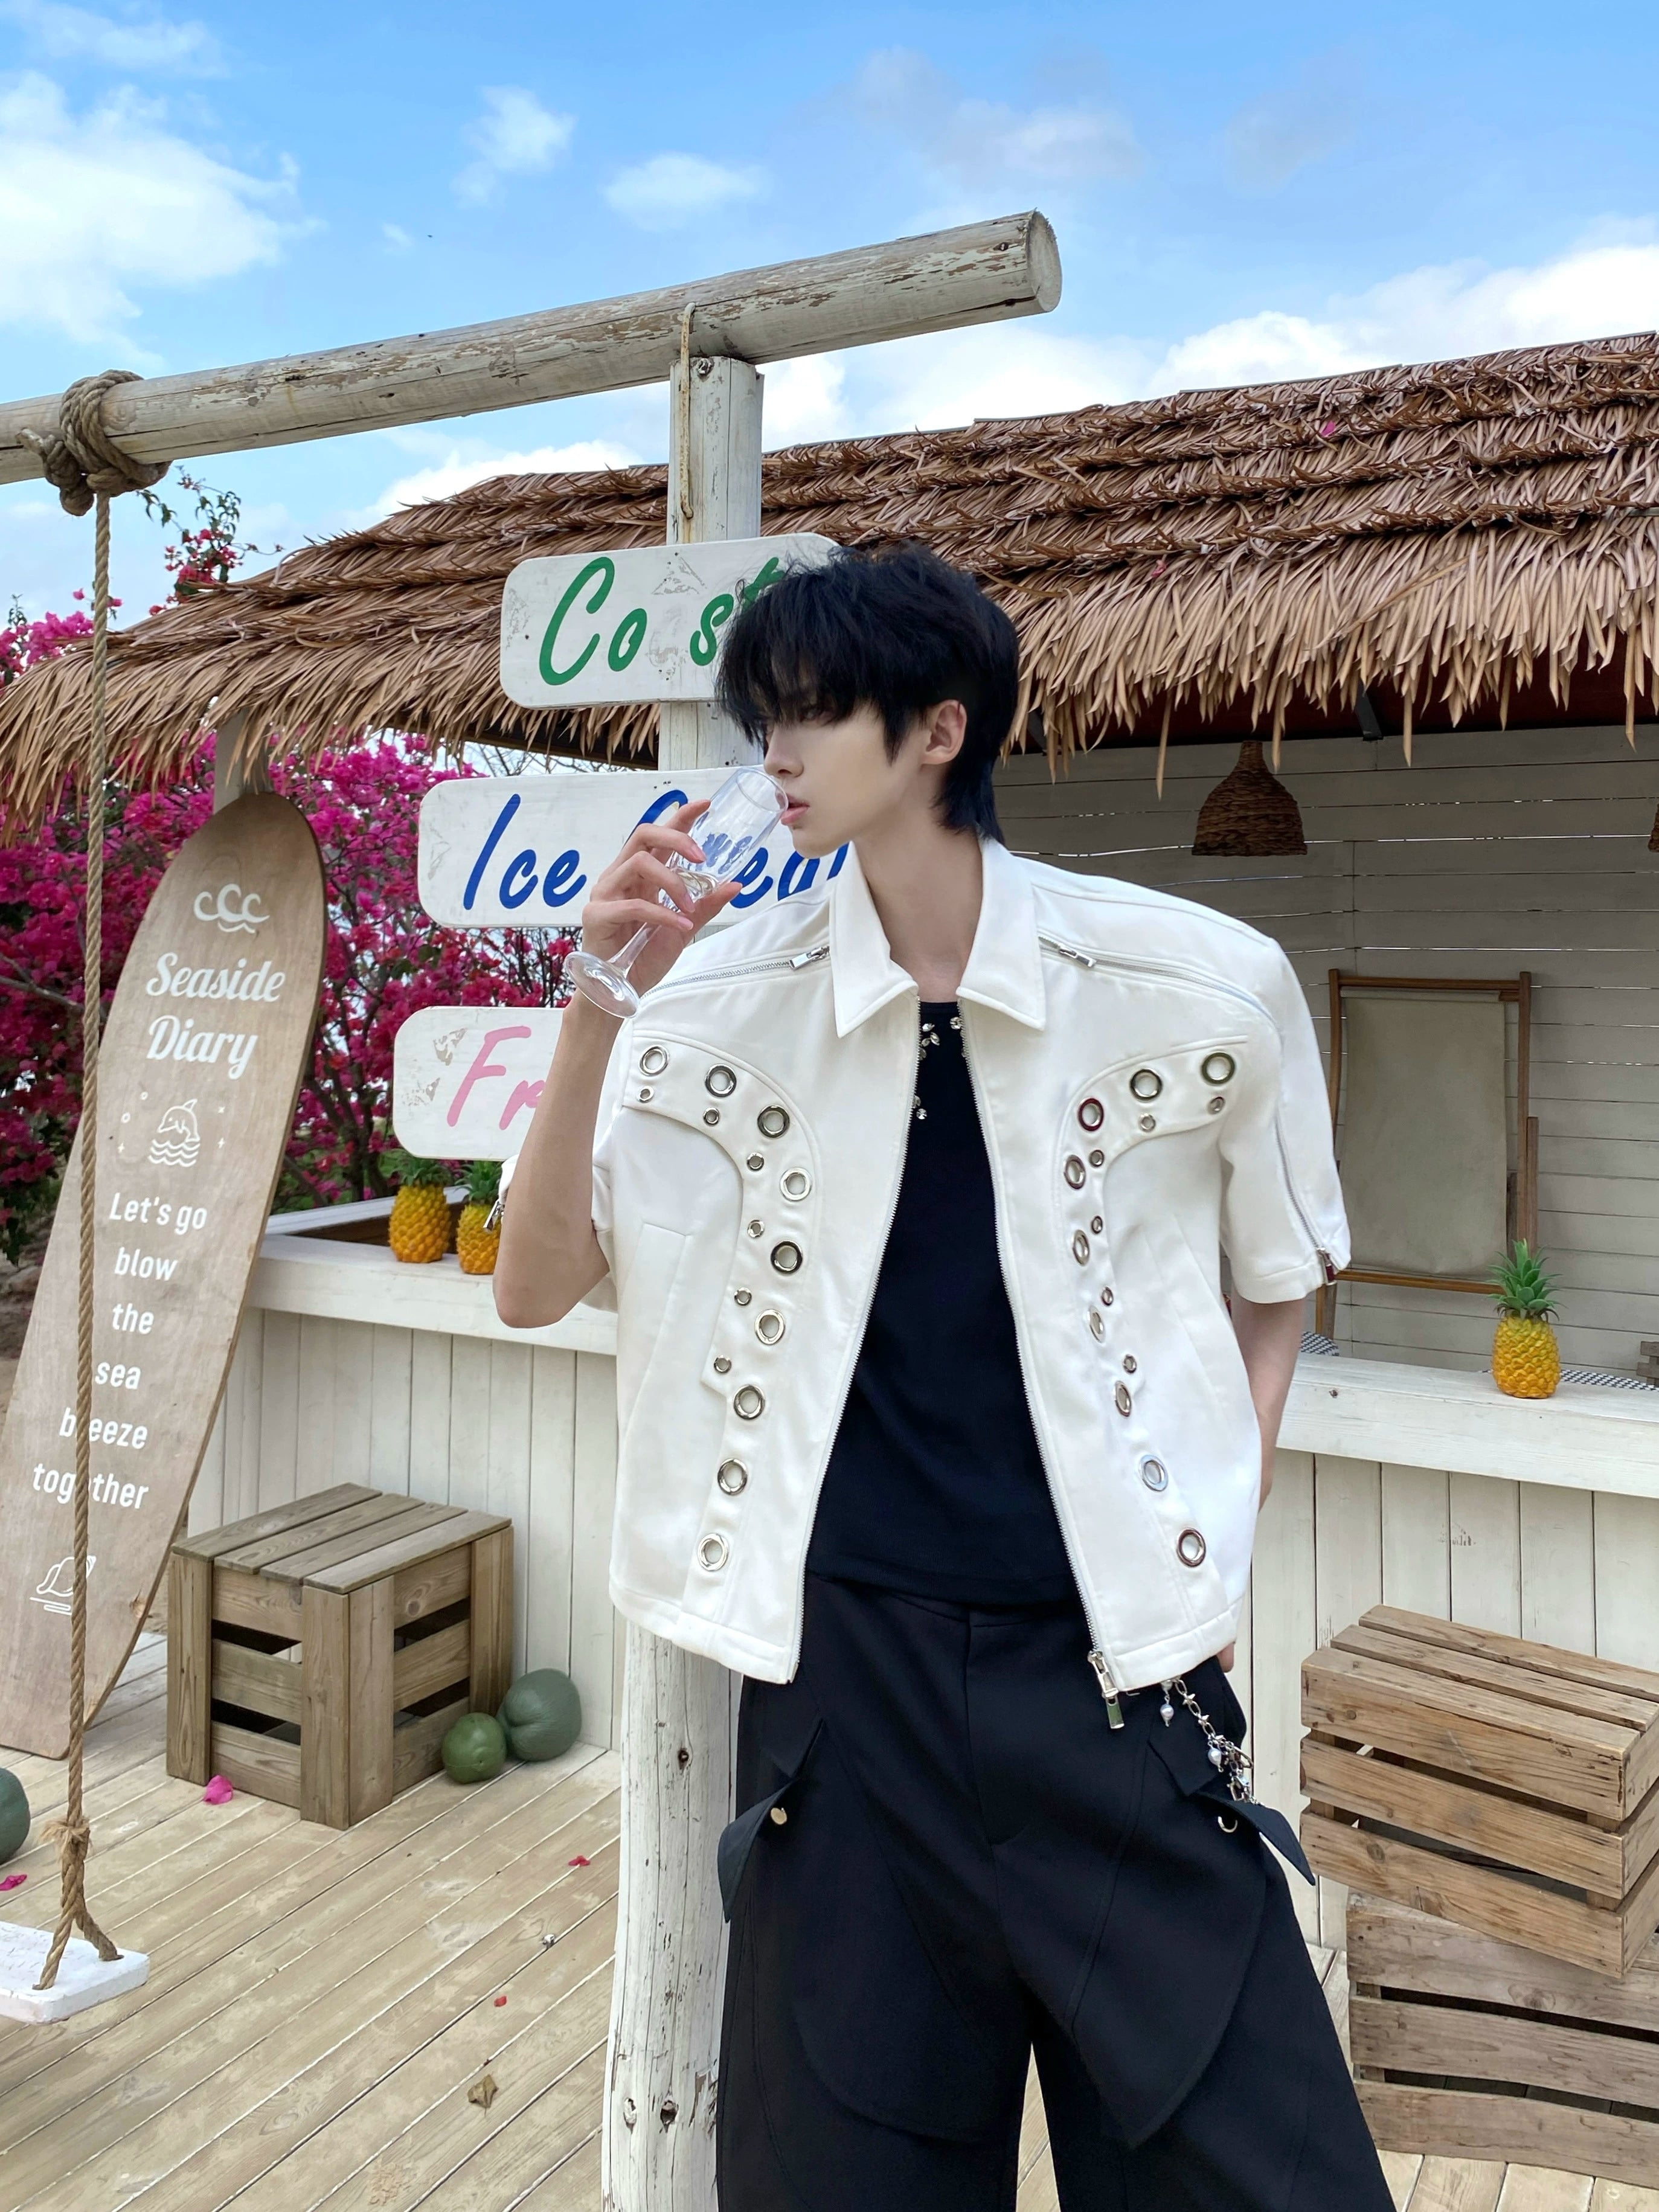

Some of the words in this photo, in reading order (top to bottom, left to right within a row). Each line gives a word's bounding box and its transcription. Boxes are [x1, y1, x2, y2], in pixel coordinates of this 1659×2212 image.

[463, 793, 587, 910] Ice
[146, 952, 286, 1002] Seaside
[146, 1015, 258, 1080] Diary
[109, 1192, 172, 1226] Let's
[175, 1205, 208, 1236] go
[114, 1246, 178, 1281] blow
[112, 1303, 155, 1335] the
[95, 1361, 141, 1390] sea
[59, 1406, 149, 1449] beeze
[33, 1463, 150, 1509] togther
